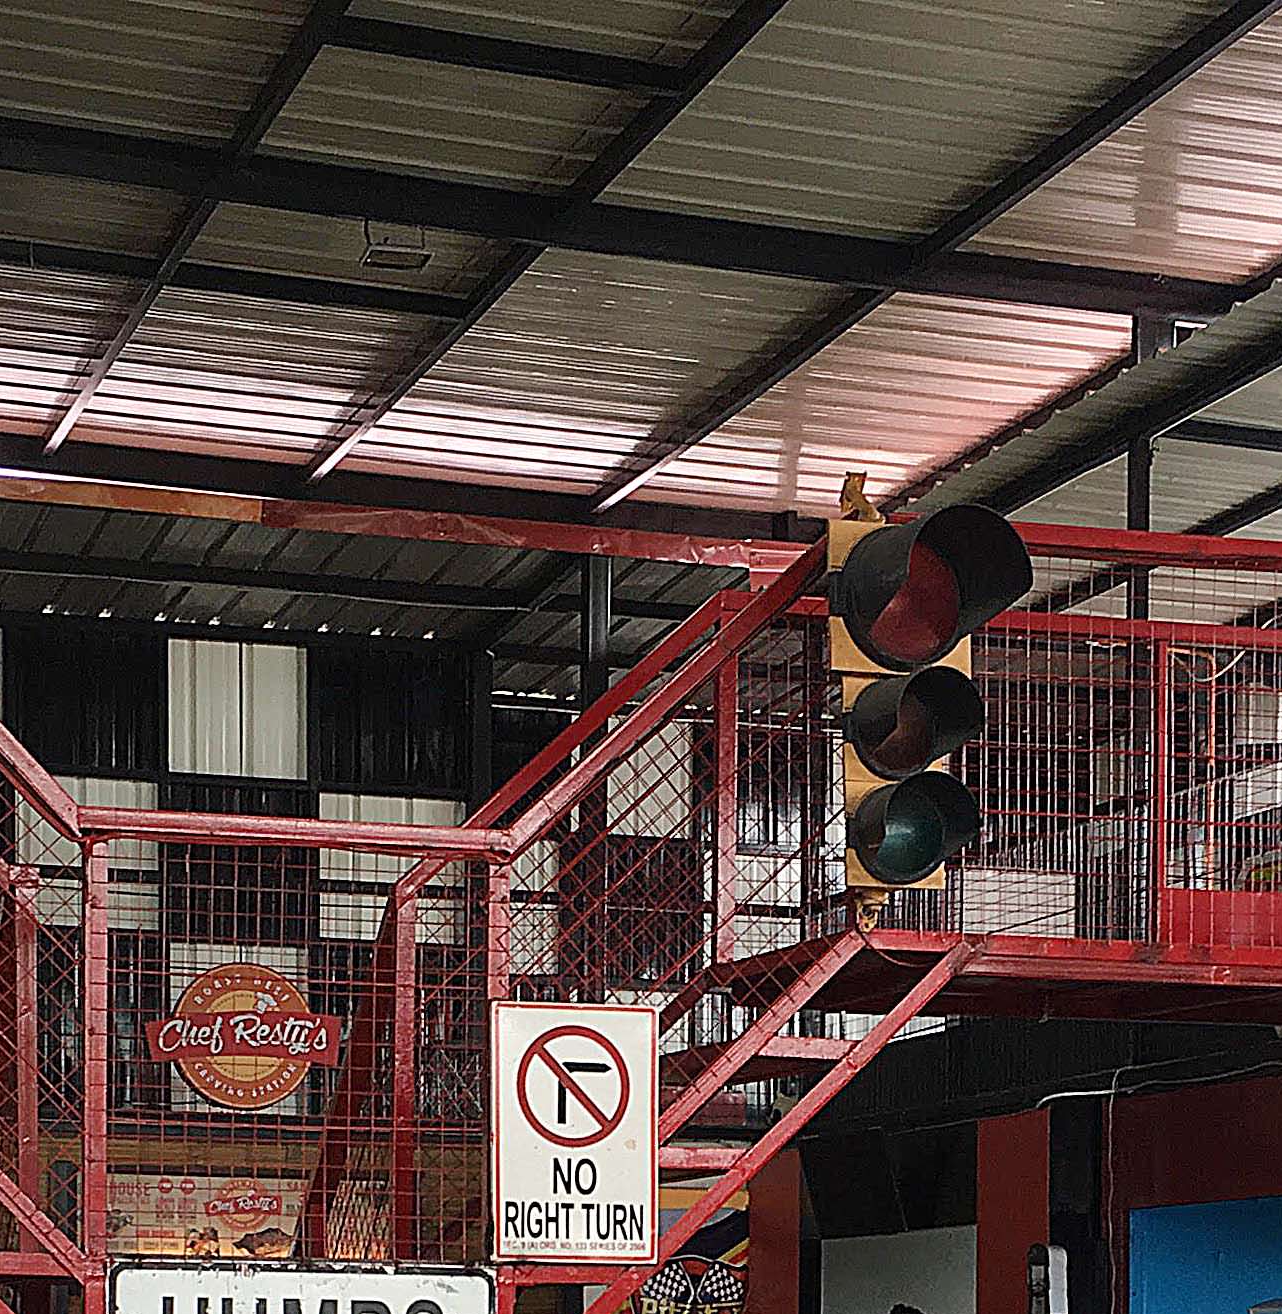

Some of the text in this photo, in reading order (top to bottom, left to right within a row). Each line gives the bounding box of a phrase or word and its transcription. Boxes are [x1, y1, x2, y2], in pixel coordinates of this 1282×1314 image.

[158, 1014, 328, 1056] Chef Resty's
[193, 1062, 246, 1098] CARVING
[251, 1063, 299, 1098] STATION
[552, 1157, 597, 1195] NO
[504, 1201, 644, 1241] RIGHT TURN
